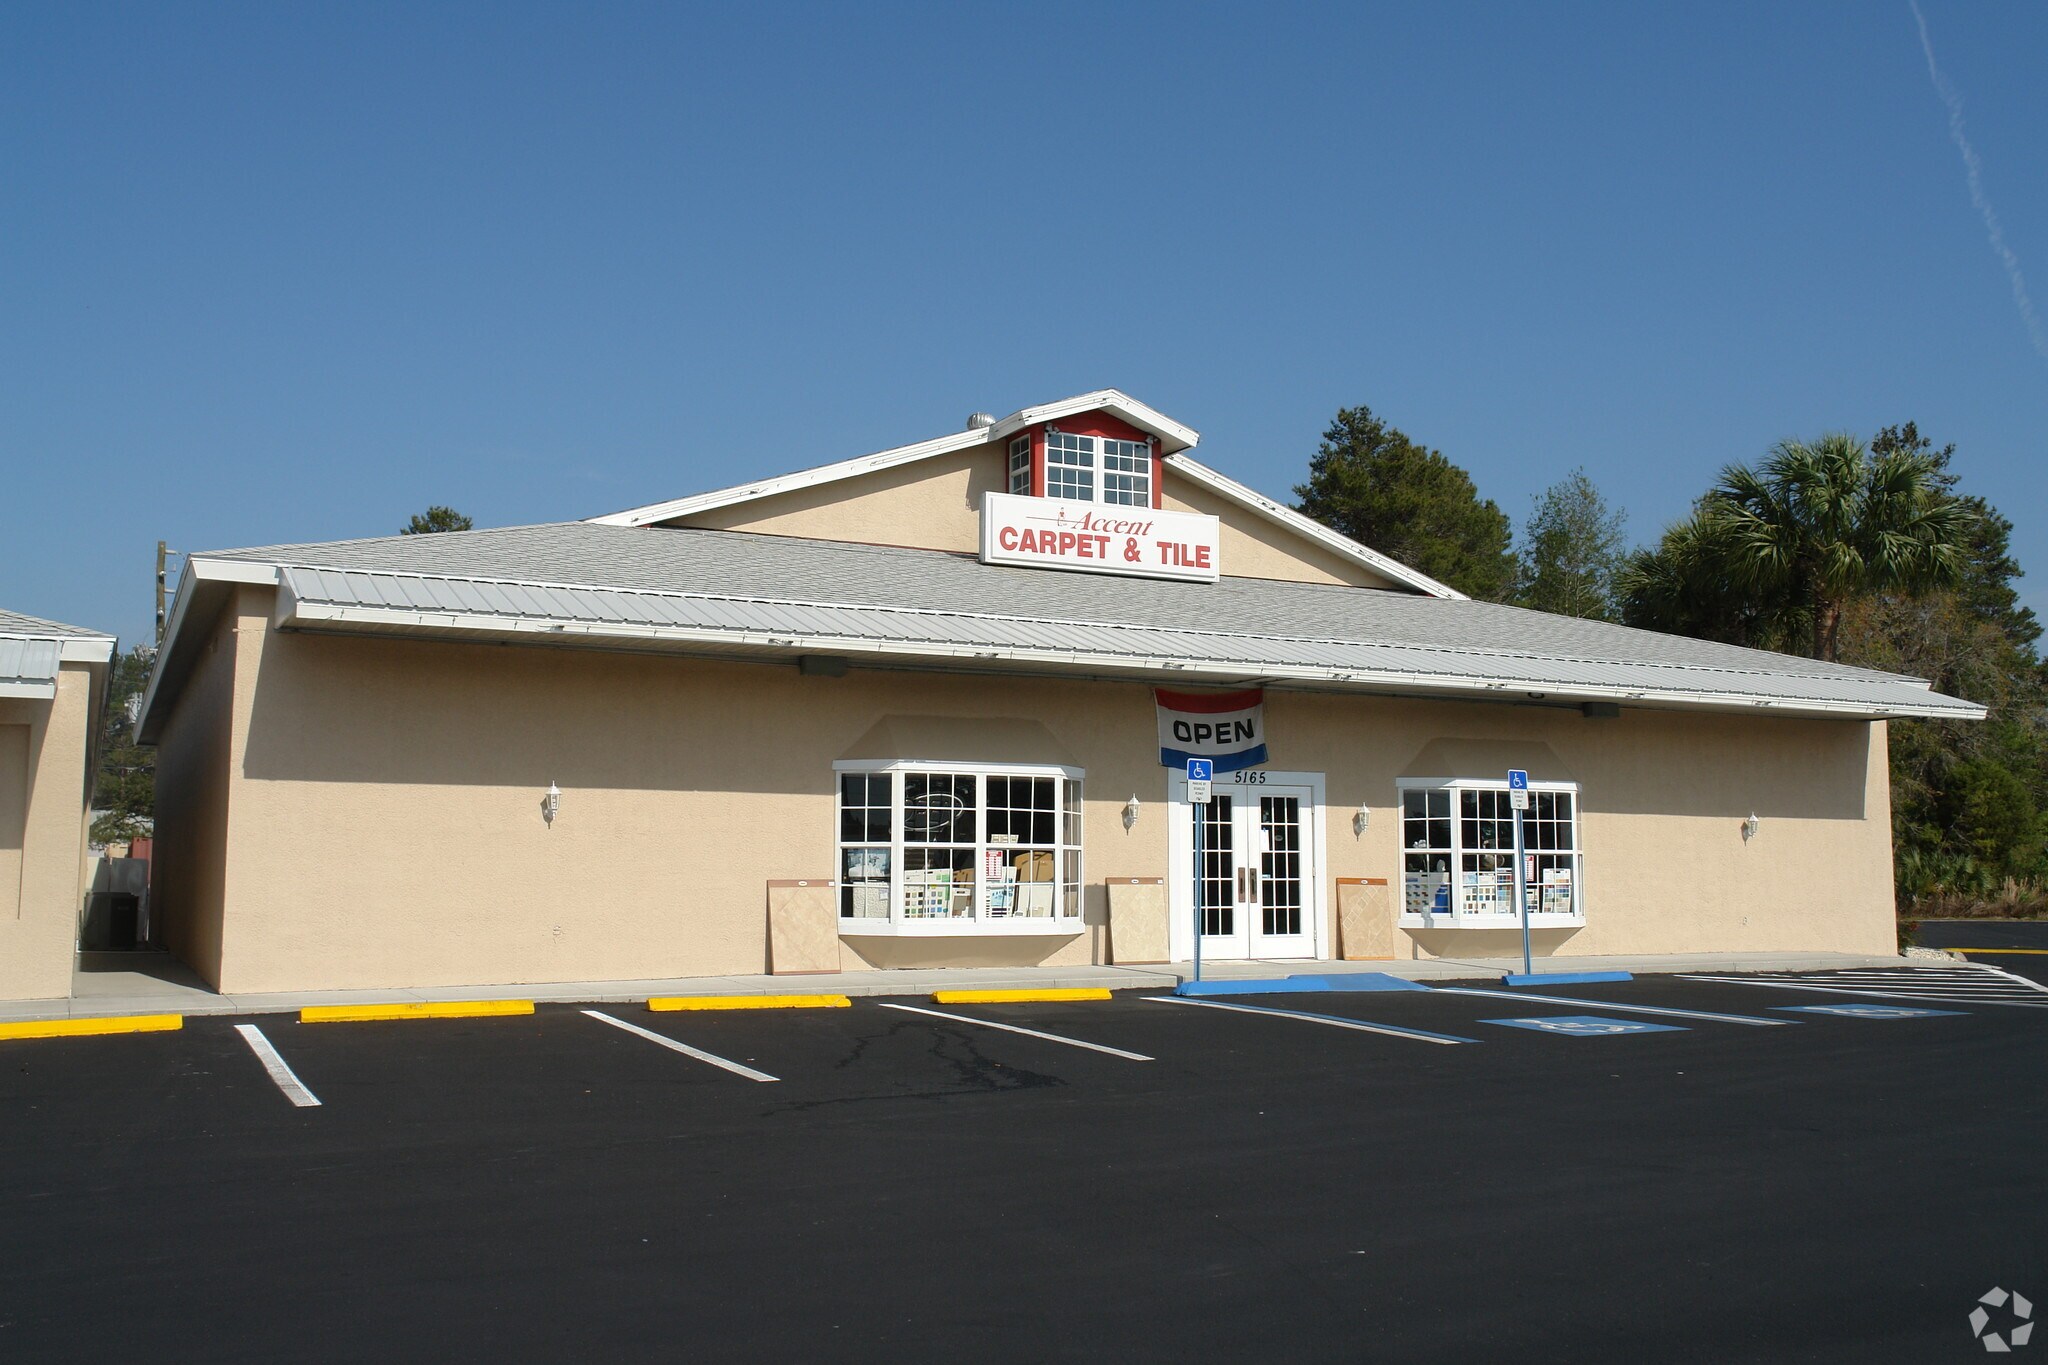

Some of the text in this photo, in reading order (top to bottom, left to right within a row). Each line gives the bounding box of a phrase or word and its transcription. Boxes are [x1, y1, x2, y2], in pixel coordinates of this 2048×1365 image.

[1072, 511, 1154, 536] Accent
[999, 526, 1211, 569] CARPET & TILE
[1173, 718, 1255, 745] OPEN
[1234, 771, 1266, 784] 5165
